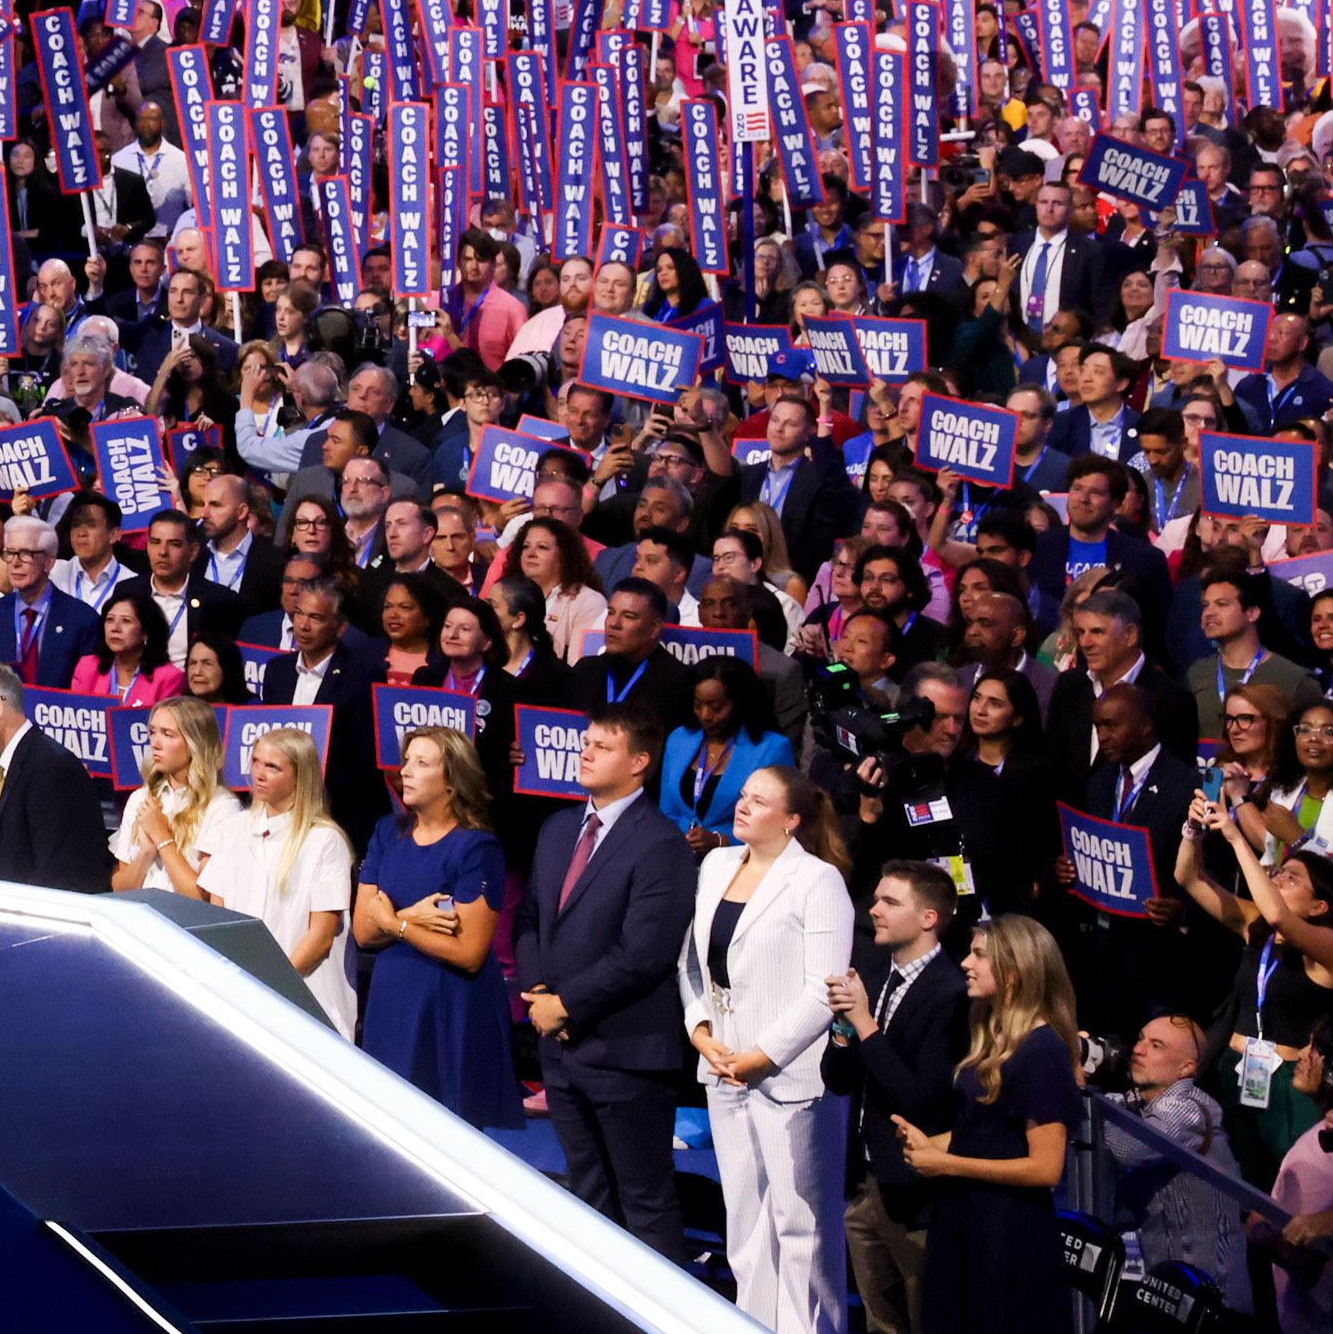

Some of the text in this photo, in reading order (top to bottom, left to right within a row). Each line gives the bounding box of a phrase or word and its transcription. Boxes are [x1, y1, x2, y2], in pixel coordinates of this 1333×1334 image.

[45, 15, 88, 183] COACH WALZ
[915, 4, 932, 159] COACH WALZ
[737, 113, 745, 138] DNC
[878, 55, 893, 214] COACH WALZ
[1098, 163, 1166, 203] WALZ
[1103, 148, 1171, 184] COACH
[217, 106, 242, 282] COACH WALZ
[399, 108, 420, 287] COACH WALZ
[692, 105, 717, 265] COACH WALZ
[1179, 304, 1253, 331] COACH
[603, 330, 682, 365] COACH
[726, 334, 779, 355] COACH
[809, 329, 846, 351] COACH
[858, 329, 908, 350] OACH
[1179, 324, 1252, 358] WALZ
[601, 356, 678, 392] WALZ
[811, 348, 857, 376] WALZ
[932, 409, 1000, 442] COACH
[929, 431, 997, 472] WALZ
[1213, 449, 1294, 478] COACH
[109, 438, 136, 514] COACH
[130, 435, 161, 512] WALZ
[1214, 473, 1294, 511] WALZ
[34, 703, 106, 732] COACH
[393, 702, 466, 730] COACH
[1071, 825, 1131, 867] COACH
[1072, 851, 1136, 900] WALZ
[1136, 1288, 1176, 1317] CENTER
[1143, 1276, 1181, 1300] UNITED
